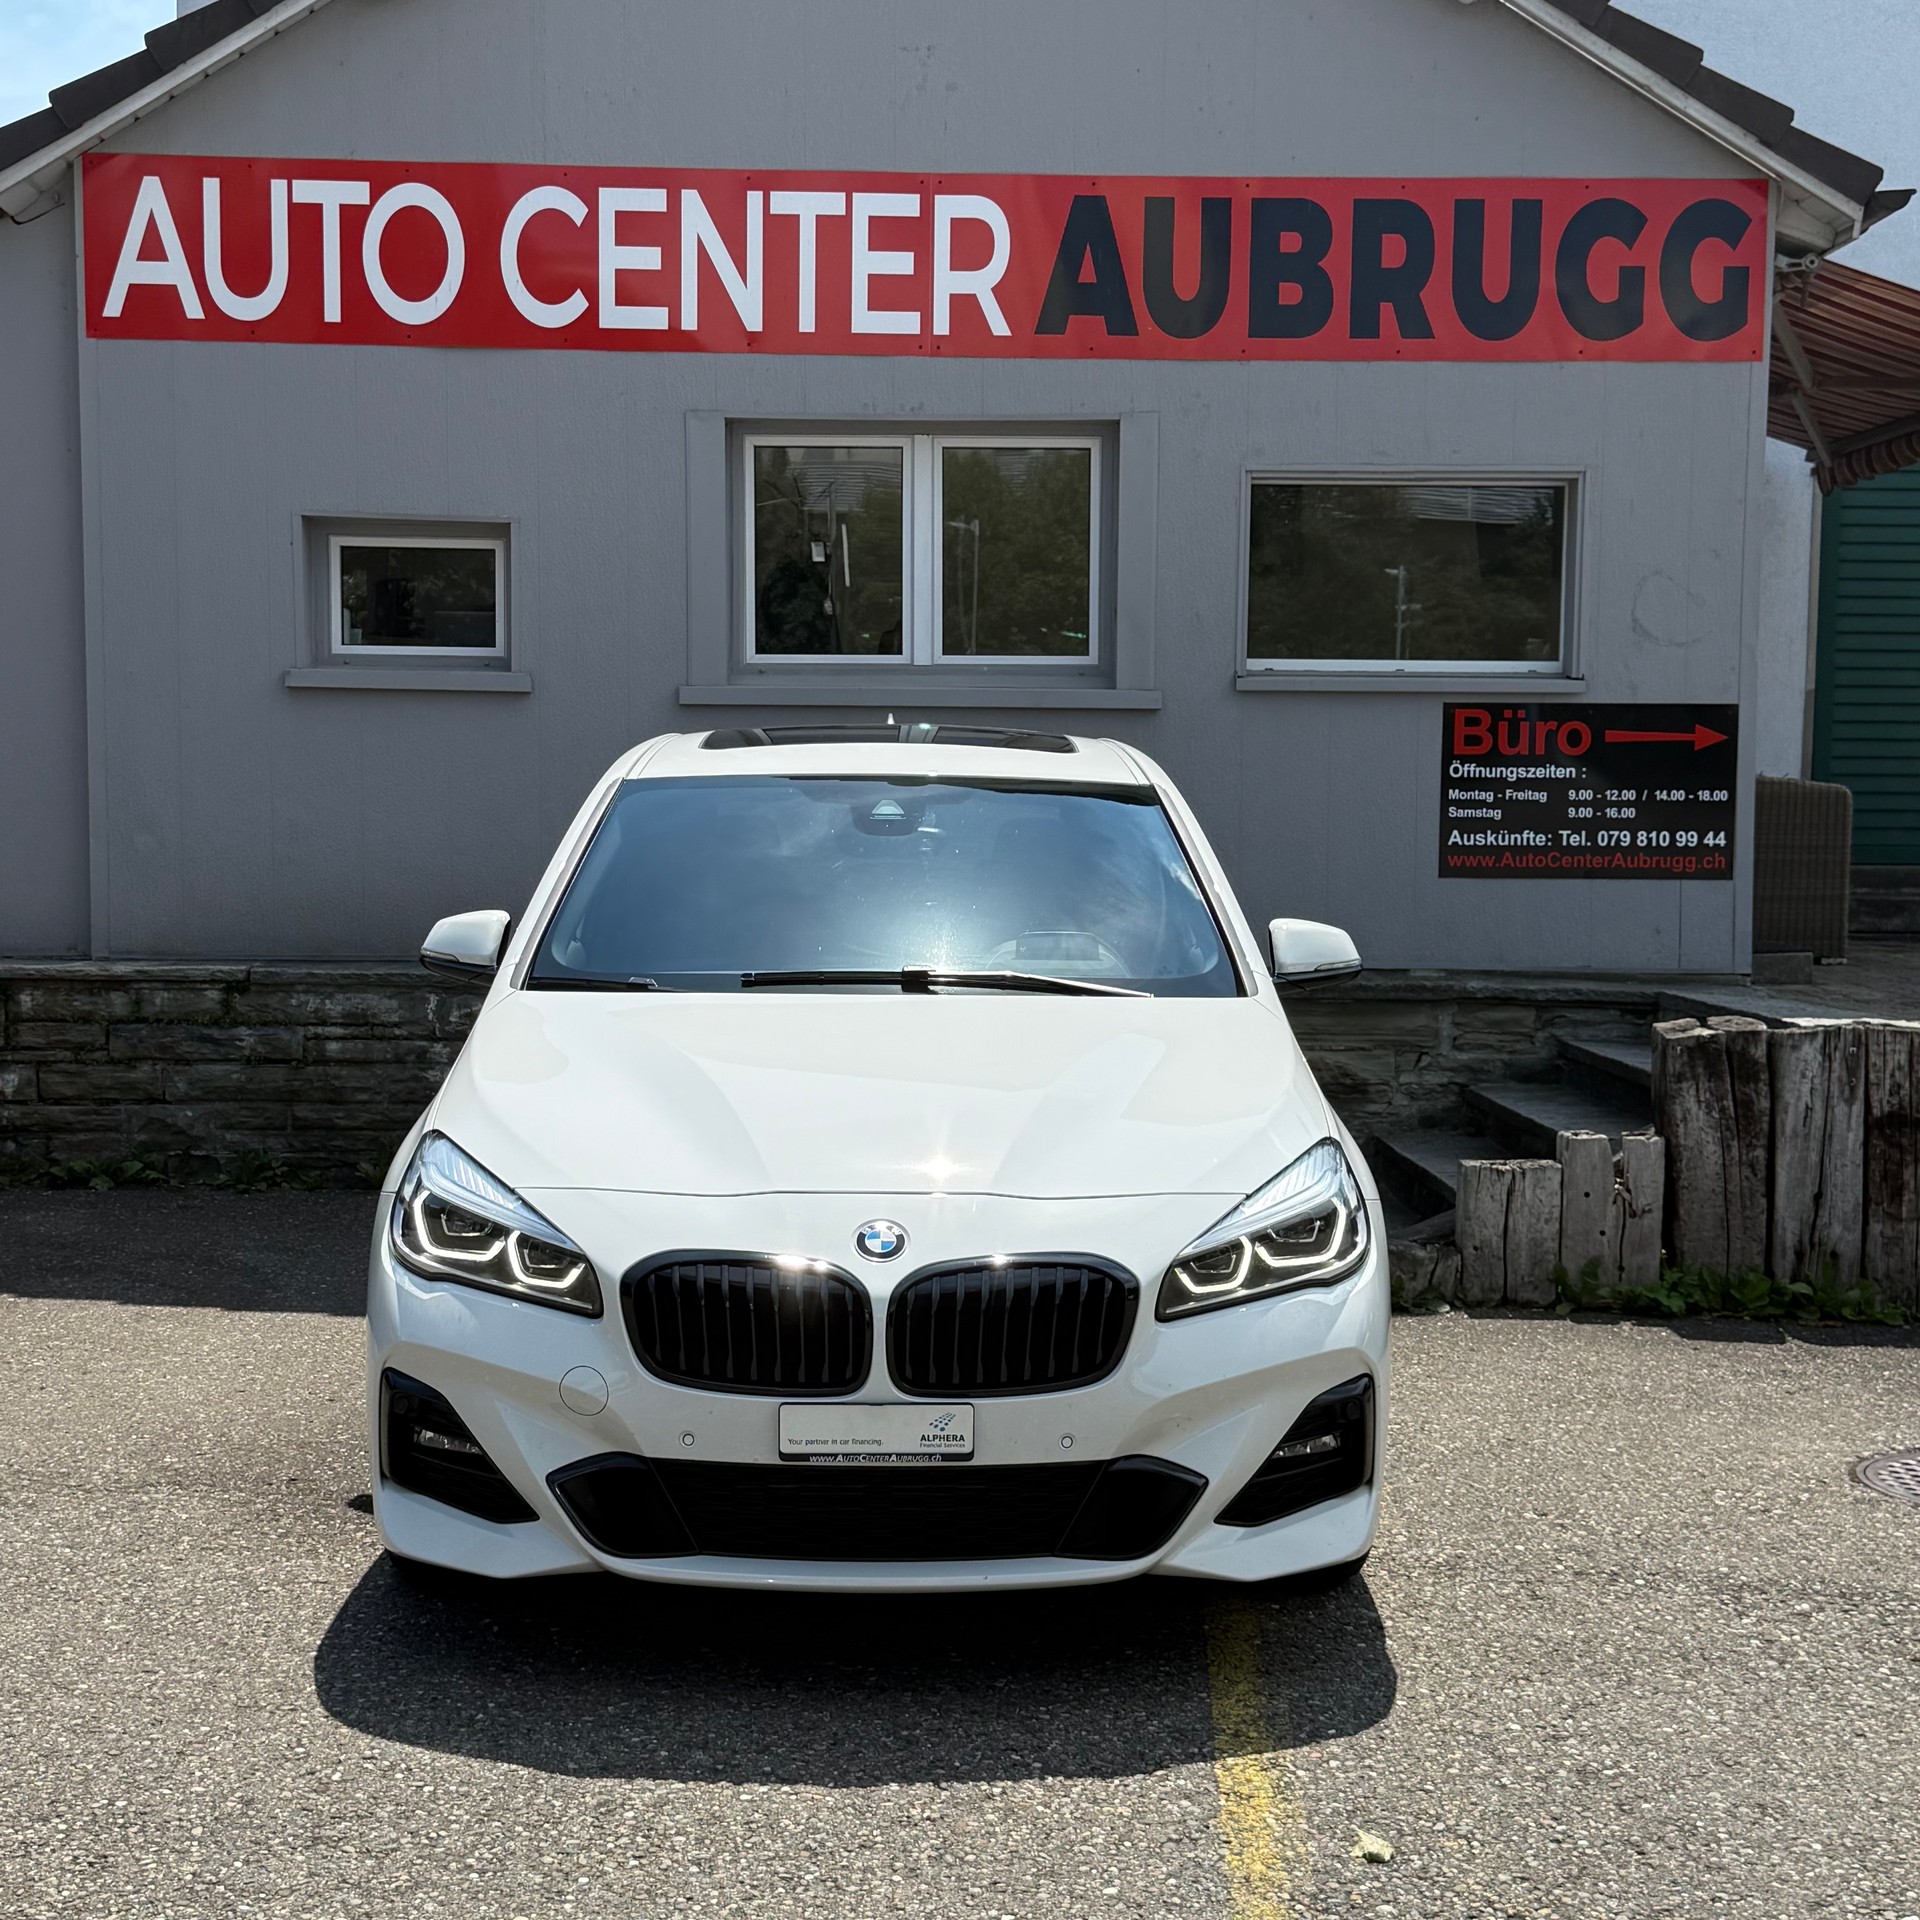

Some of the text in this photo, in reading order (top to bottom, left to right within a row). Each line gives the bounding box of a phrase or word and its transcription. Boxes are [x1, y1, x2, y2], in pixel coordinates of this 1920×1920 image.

[102, 175, 1753, 342] AUTO CENTER AUBRUGG
[1453, 708, 1592, 756] Büro
[1449, 760, 1576, 781] Öffnungszeiten
[1448, 789, 1494, 802] Montag
[1505, 789, 1548, 803] Freitag
[1568, 789, 1593, 801] 9.00
[1604, 789, 1636, 801] 12.00
[1654, 790, 1685, 801] 14.00
[1697, 790, 1728, 801] 18.00
[1448, 806, 1502, 820] Samstag
[1568, 807, 1593, 818] 9.00
[1604, 807, 1636, 819] 16.00
[1447, 829, 1727, 847] Auskünfte: Tel. 079 810 99 44
[1447, 851, 1727, 872] www.AutoCenterAubrugg.ch
[805, 1438, 829, 1446] partner
[920, 1434, 966, 1442] ALPHERA
